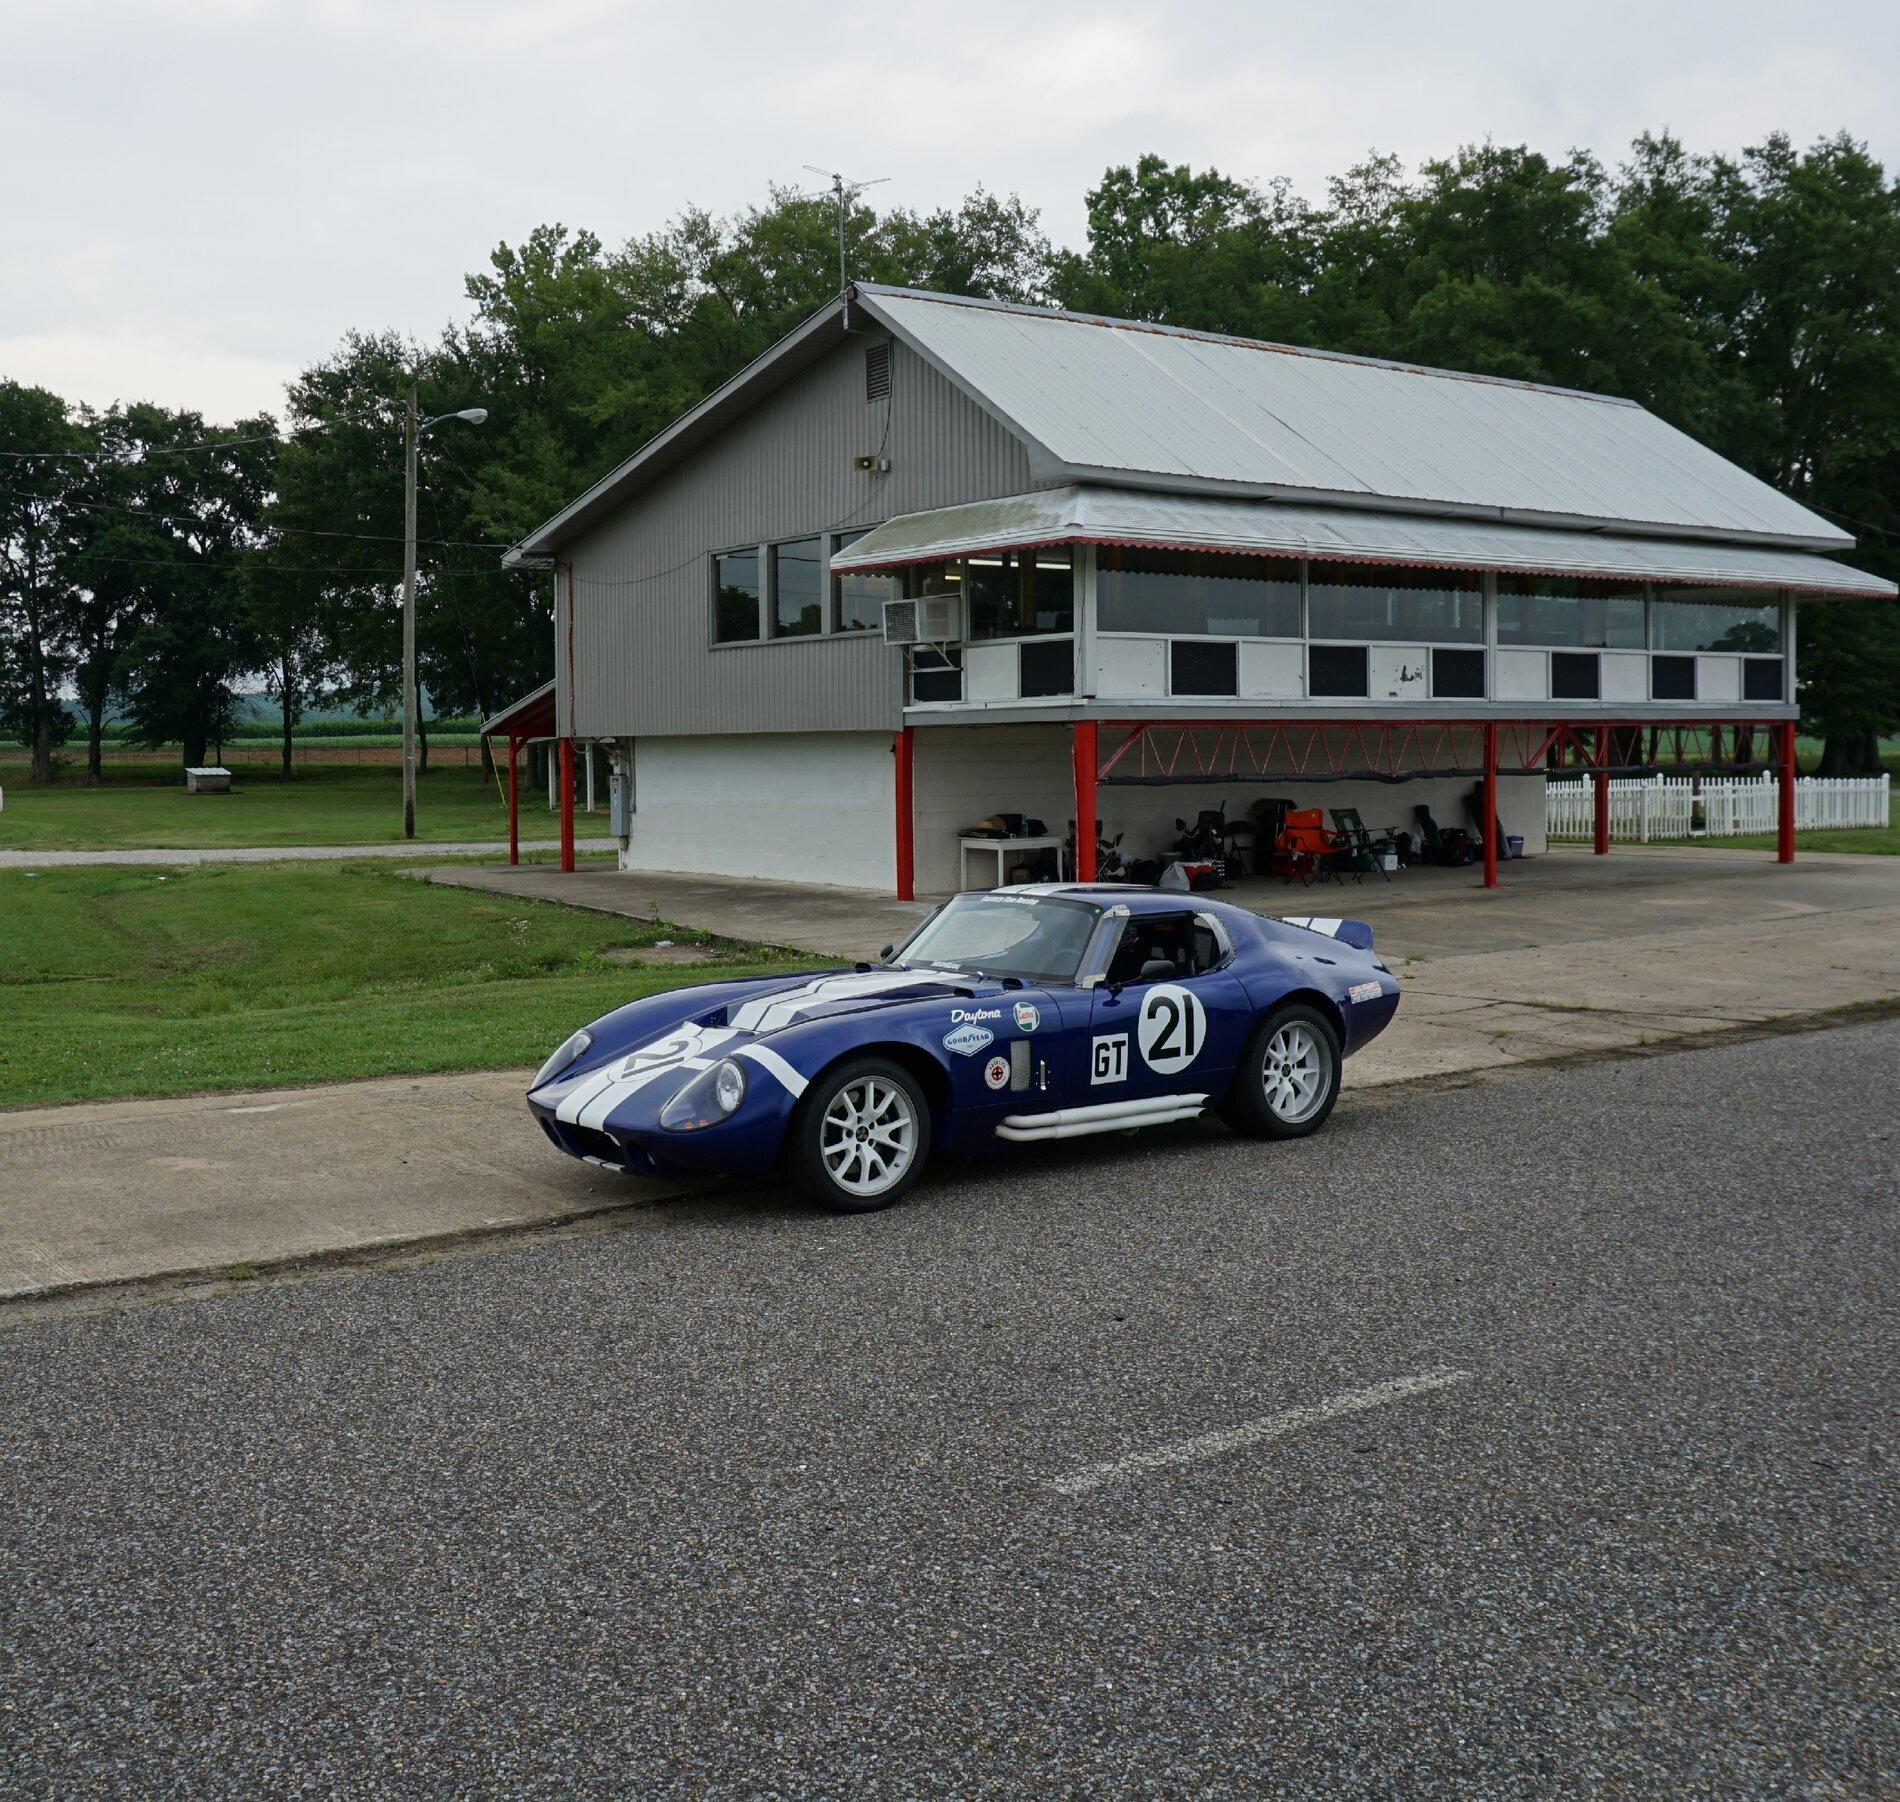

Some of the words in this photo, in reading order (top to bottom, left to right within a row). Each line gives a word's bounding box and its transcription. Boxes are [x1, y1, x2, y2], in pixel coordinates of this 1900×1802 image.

[951, 1009, 1001, 1025] Daytona
[1147, 994, 1195, 1061] 21
[948, 1033, 989, 1044] GOODYEAR
[621, 1040, 689, 1079] 21
[1094, 1040, 1126, 1078] GT
